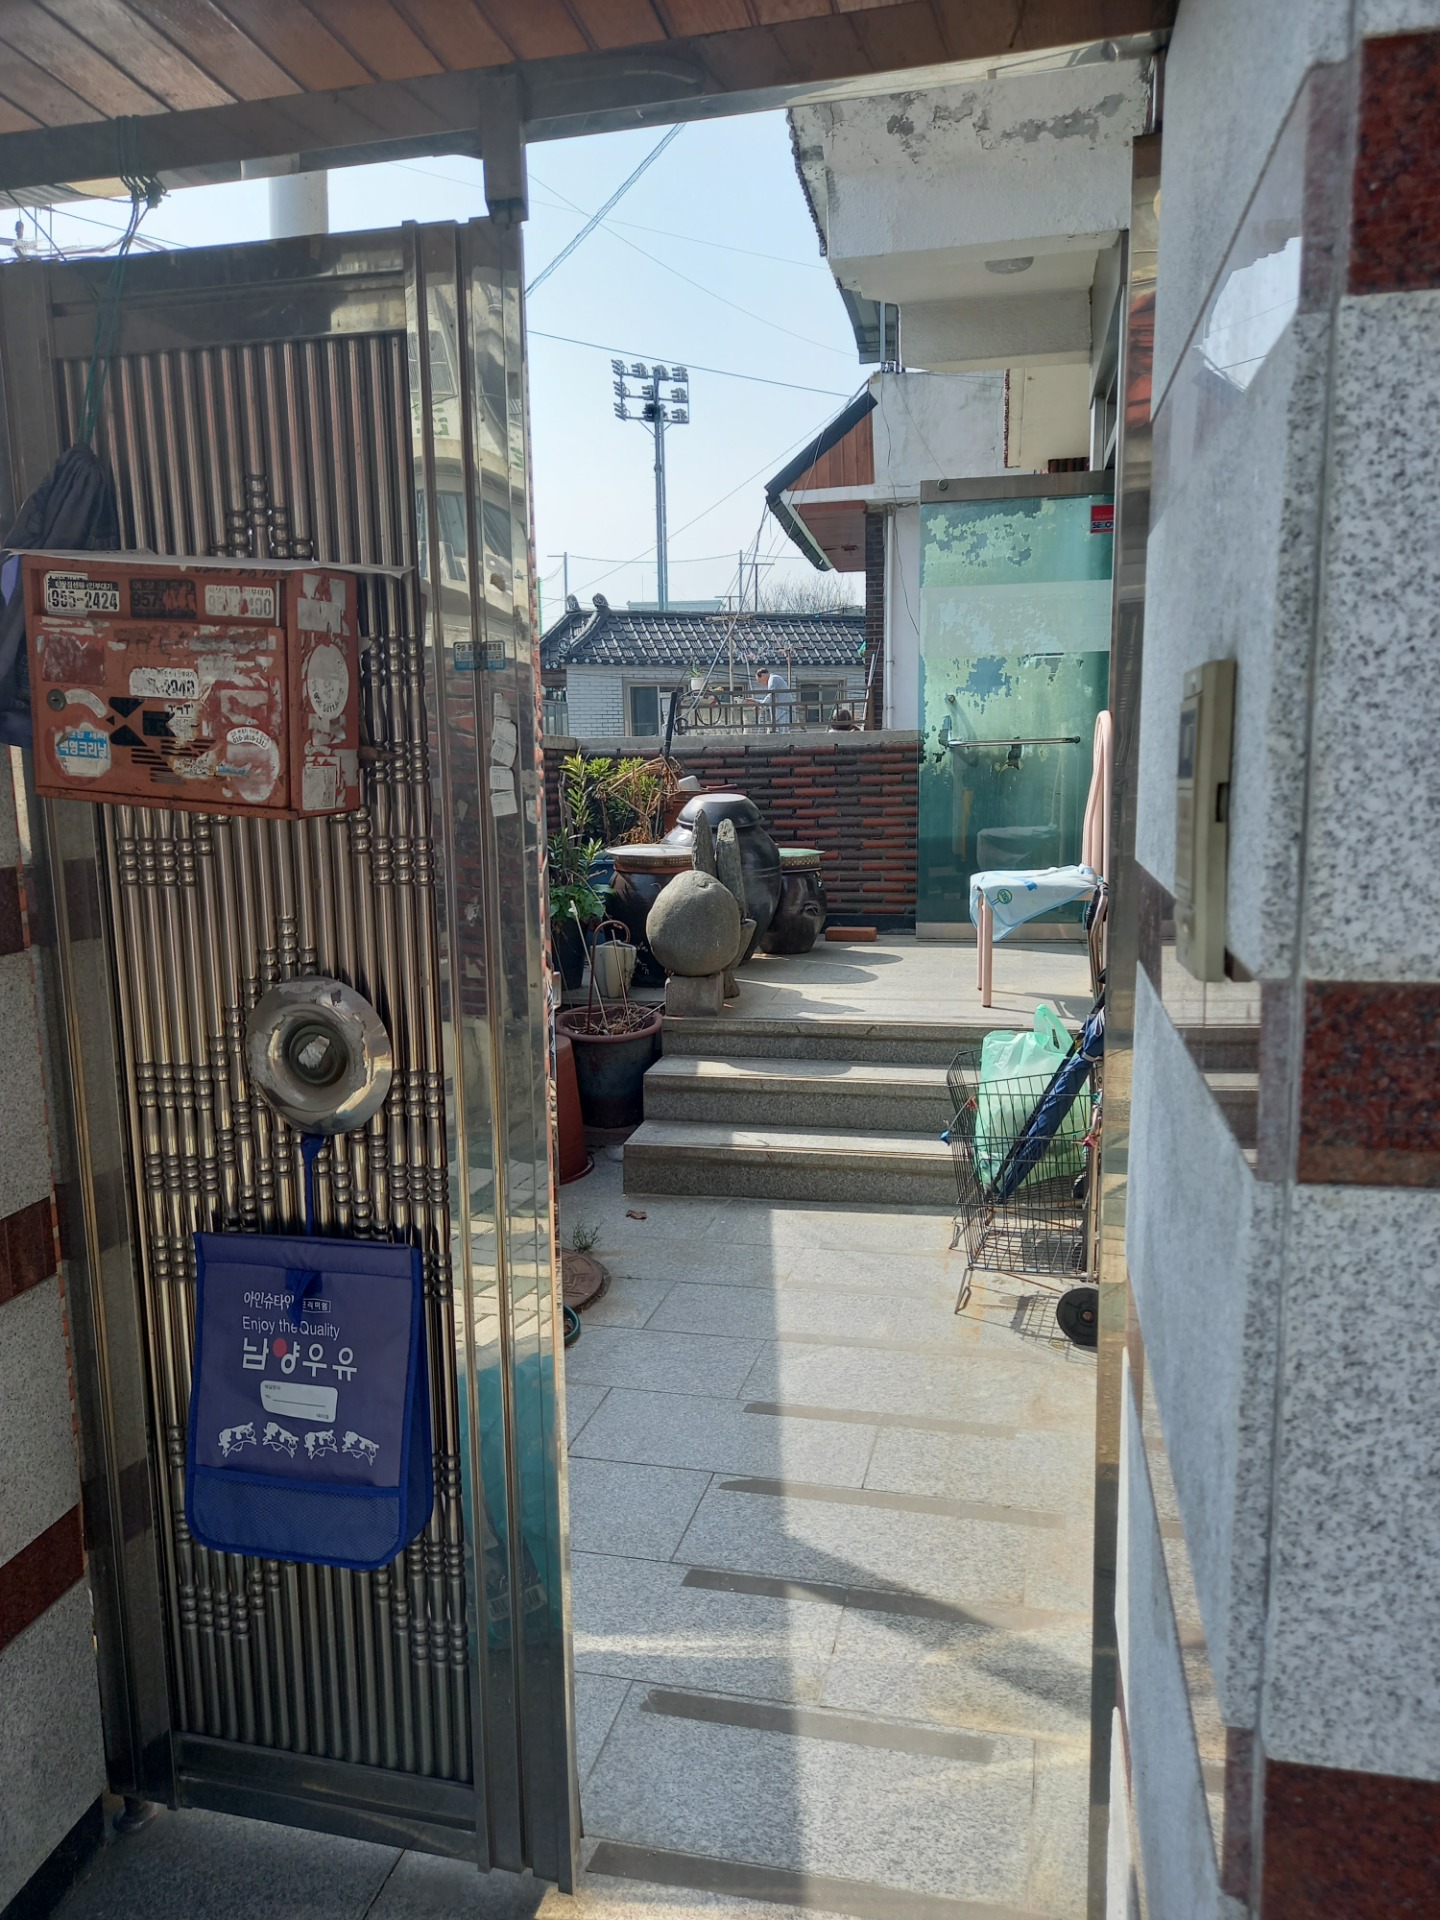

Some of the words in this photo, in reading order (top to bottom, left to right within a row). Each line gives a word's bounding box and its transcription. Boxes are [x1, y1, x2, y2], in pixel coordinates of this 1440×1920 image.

[242, 1316, 276, 1335] Enjoy
[279, 1318, 298, 1333] the
[299, 1320, 341, 1341] Quality
[242, 1337, 358, 1382] 남양우유
